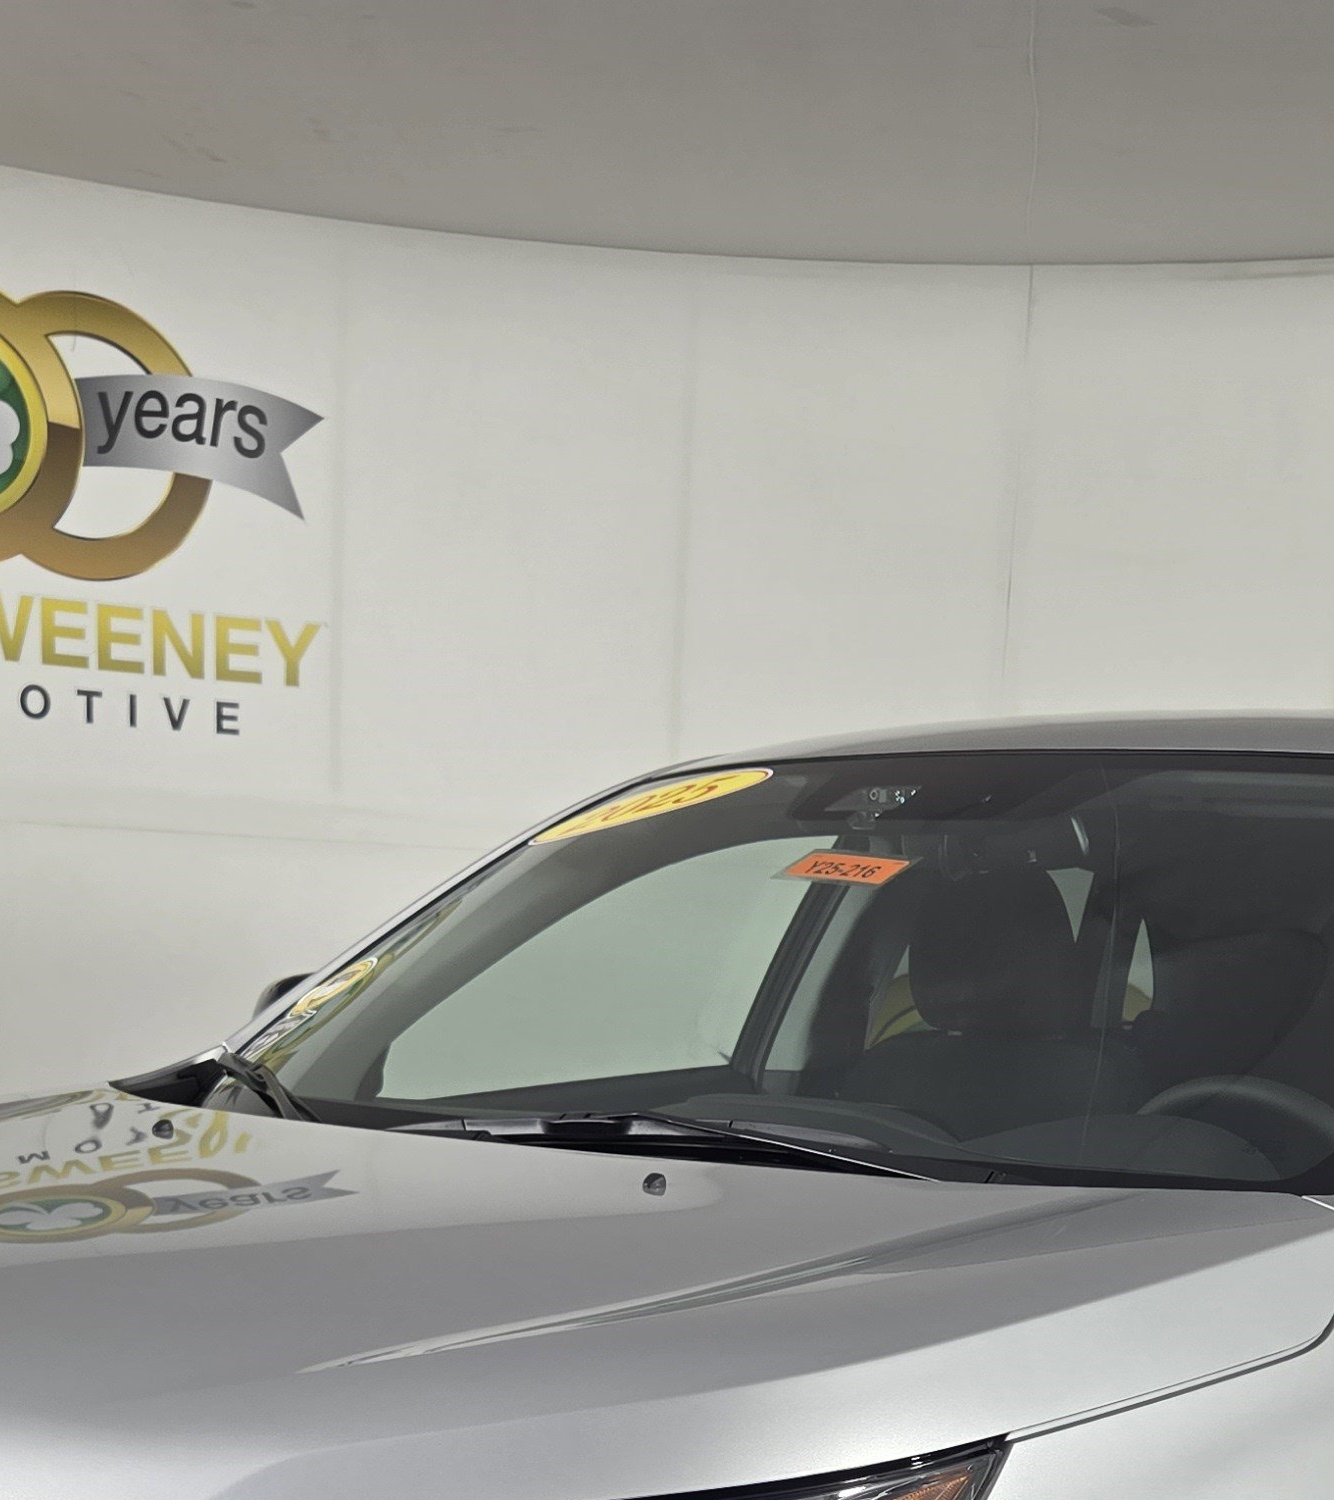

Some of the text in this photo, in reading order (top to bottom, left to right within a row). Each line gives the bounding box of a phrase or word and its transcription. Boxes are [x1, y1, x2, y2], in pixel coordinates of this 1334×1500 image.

[97, 388, 269, 459] years
[557, 774, 741, 836] 2025
[805, 861, 881, 878] Y25-216
